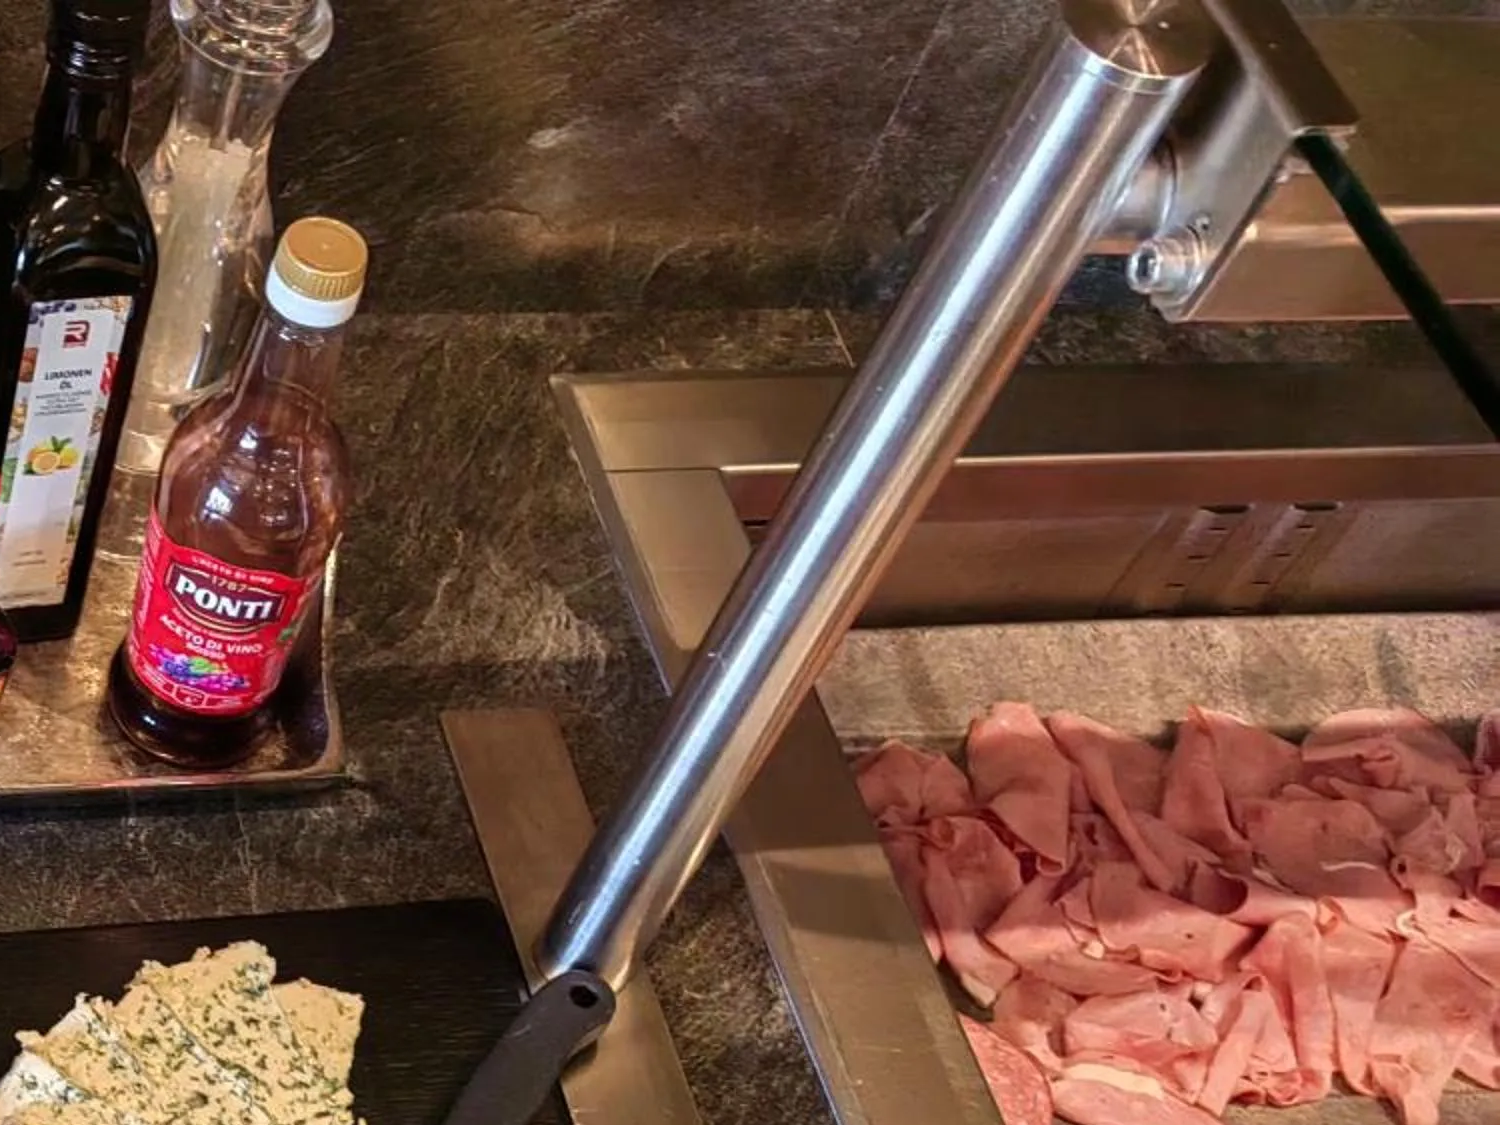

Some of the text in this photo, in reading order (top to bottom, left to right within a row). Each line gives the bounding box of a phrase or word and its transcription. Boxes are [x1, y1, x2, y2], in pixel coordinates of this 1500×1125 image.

[45, 368, 93, 380] LIMONEN
[174, 574, 273, 620] PONTI
[210, 575, 248, 593] 1787
[159, 614, 205, 646] ACETO
[205, 637, 223, 651] DI
[227, 642, 264, 655] VINO
